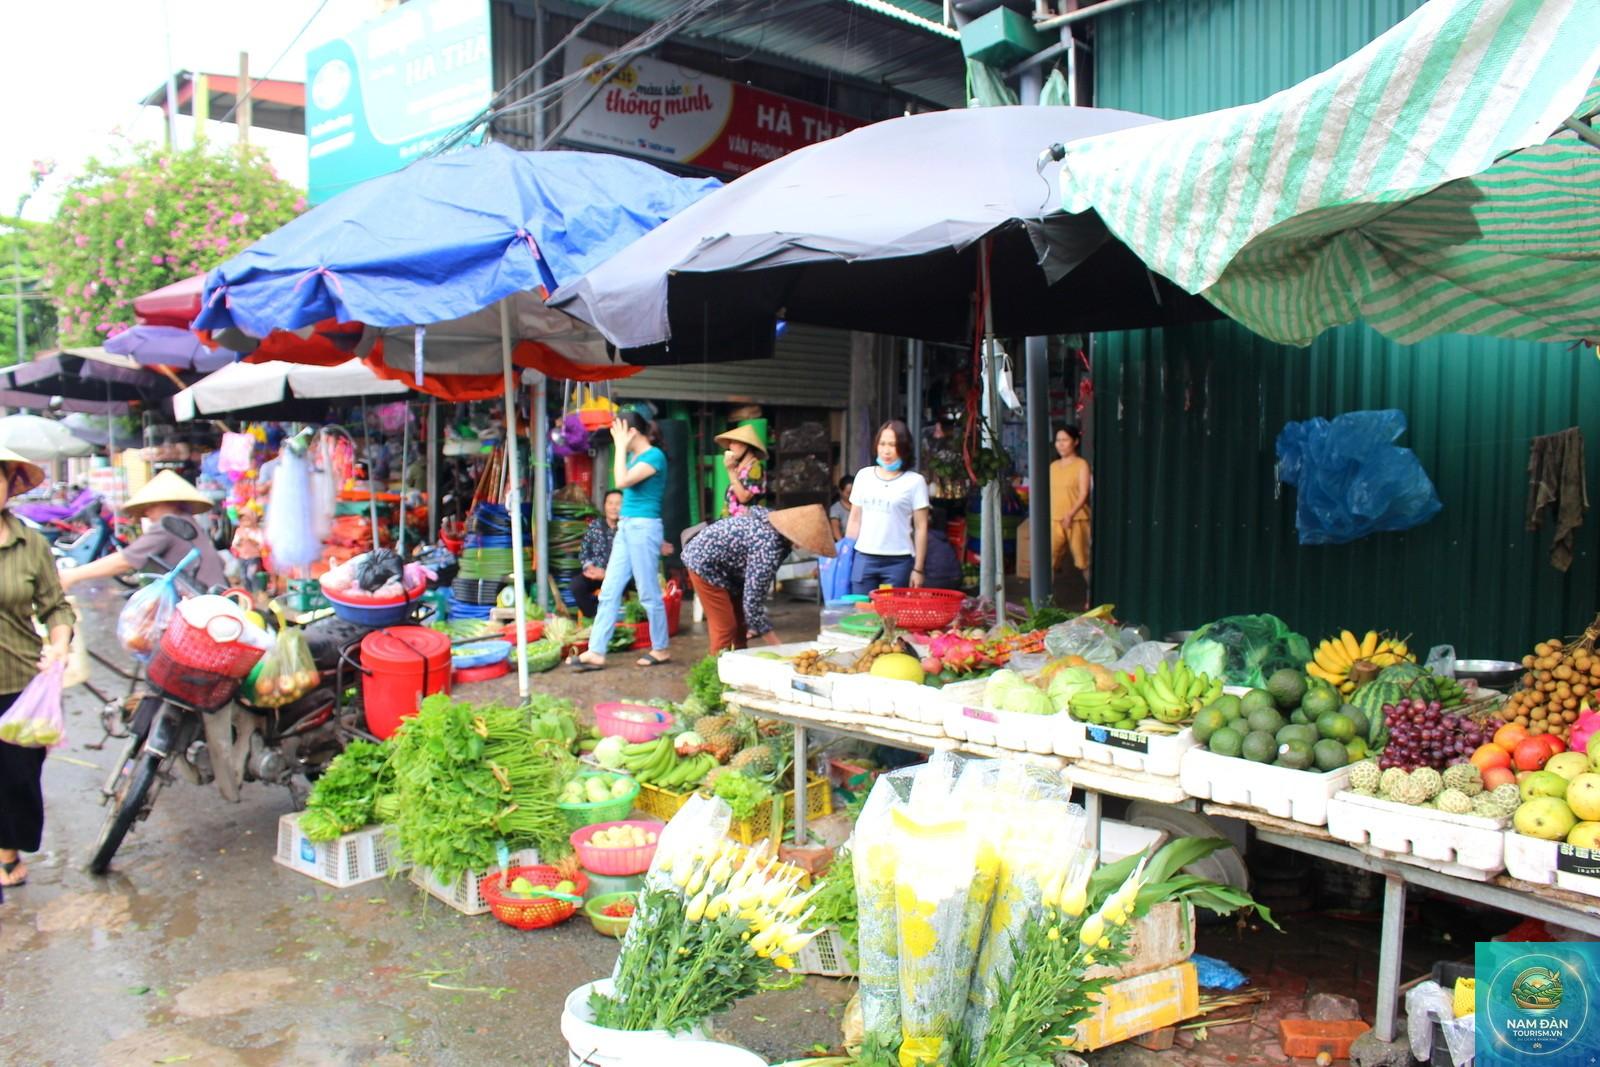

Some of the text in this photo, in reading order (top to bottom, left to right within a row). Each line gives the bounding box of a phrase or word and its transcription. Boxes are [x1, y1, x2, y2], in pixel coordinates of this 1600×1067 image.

[606, 84, 713, 130] thông minh
[757, 103, 793, 136] HÀ
